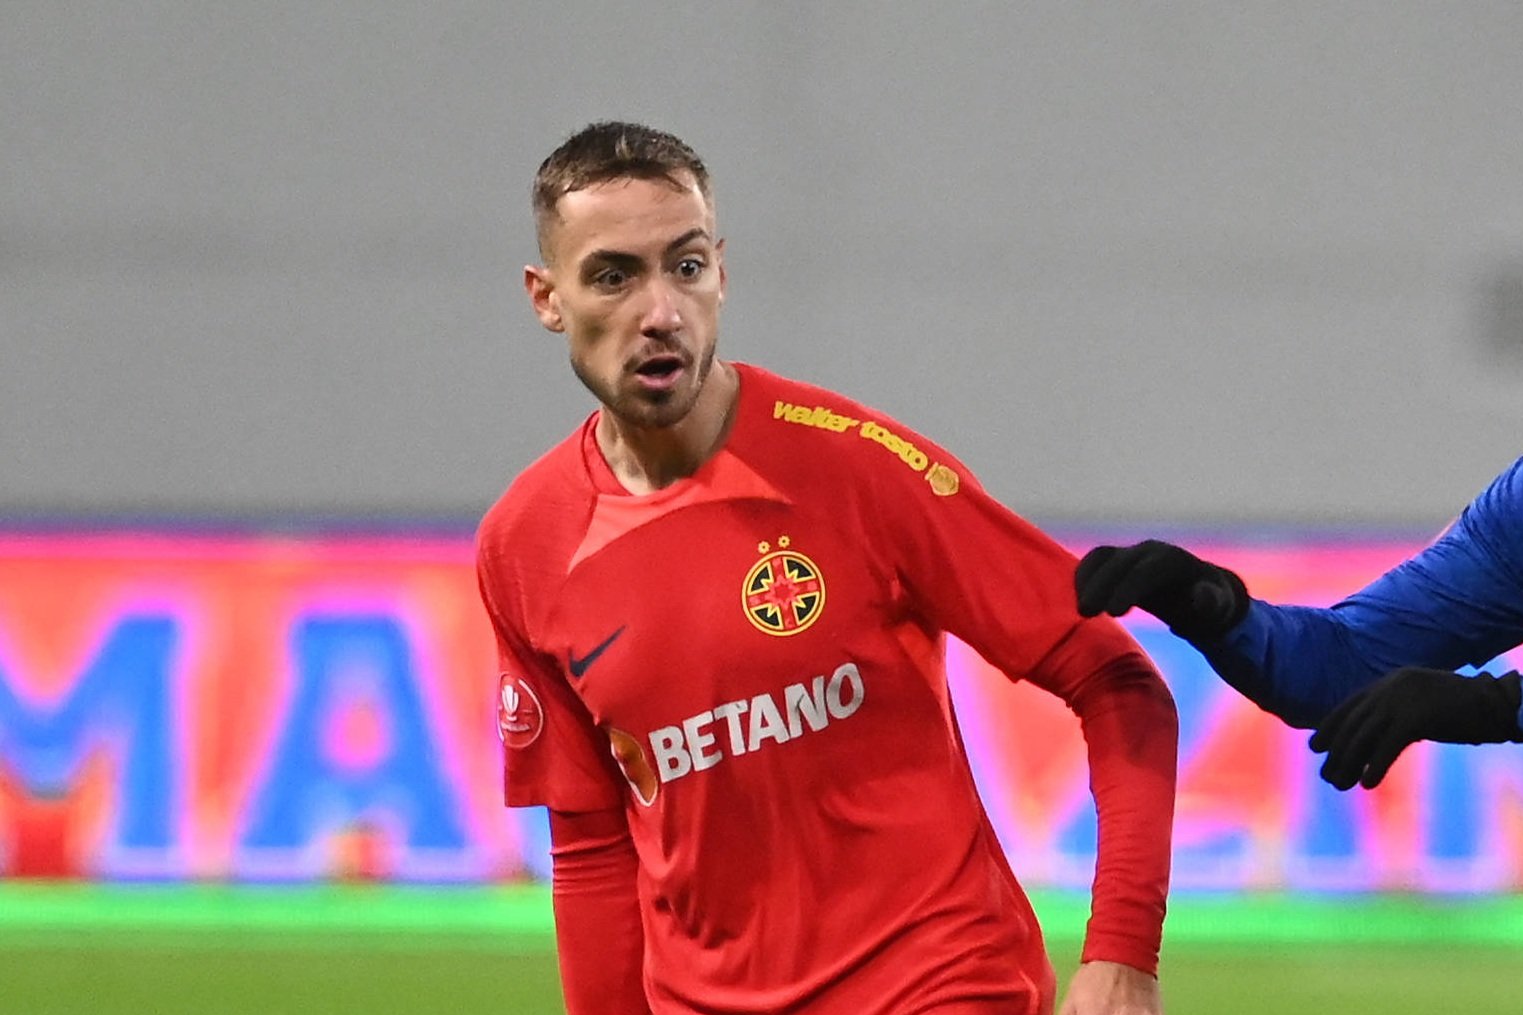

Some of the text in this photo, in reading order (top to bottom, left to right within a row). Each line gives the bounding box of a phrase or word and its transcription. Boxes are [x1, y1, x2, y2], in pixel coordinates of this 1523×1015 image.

[773, 400, 929, 472] walter tosto
[648, 662, 865, 784] BETANO
